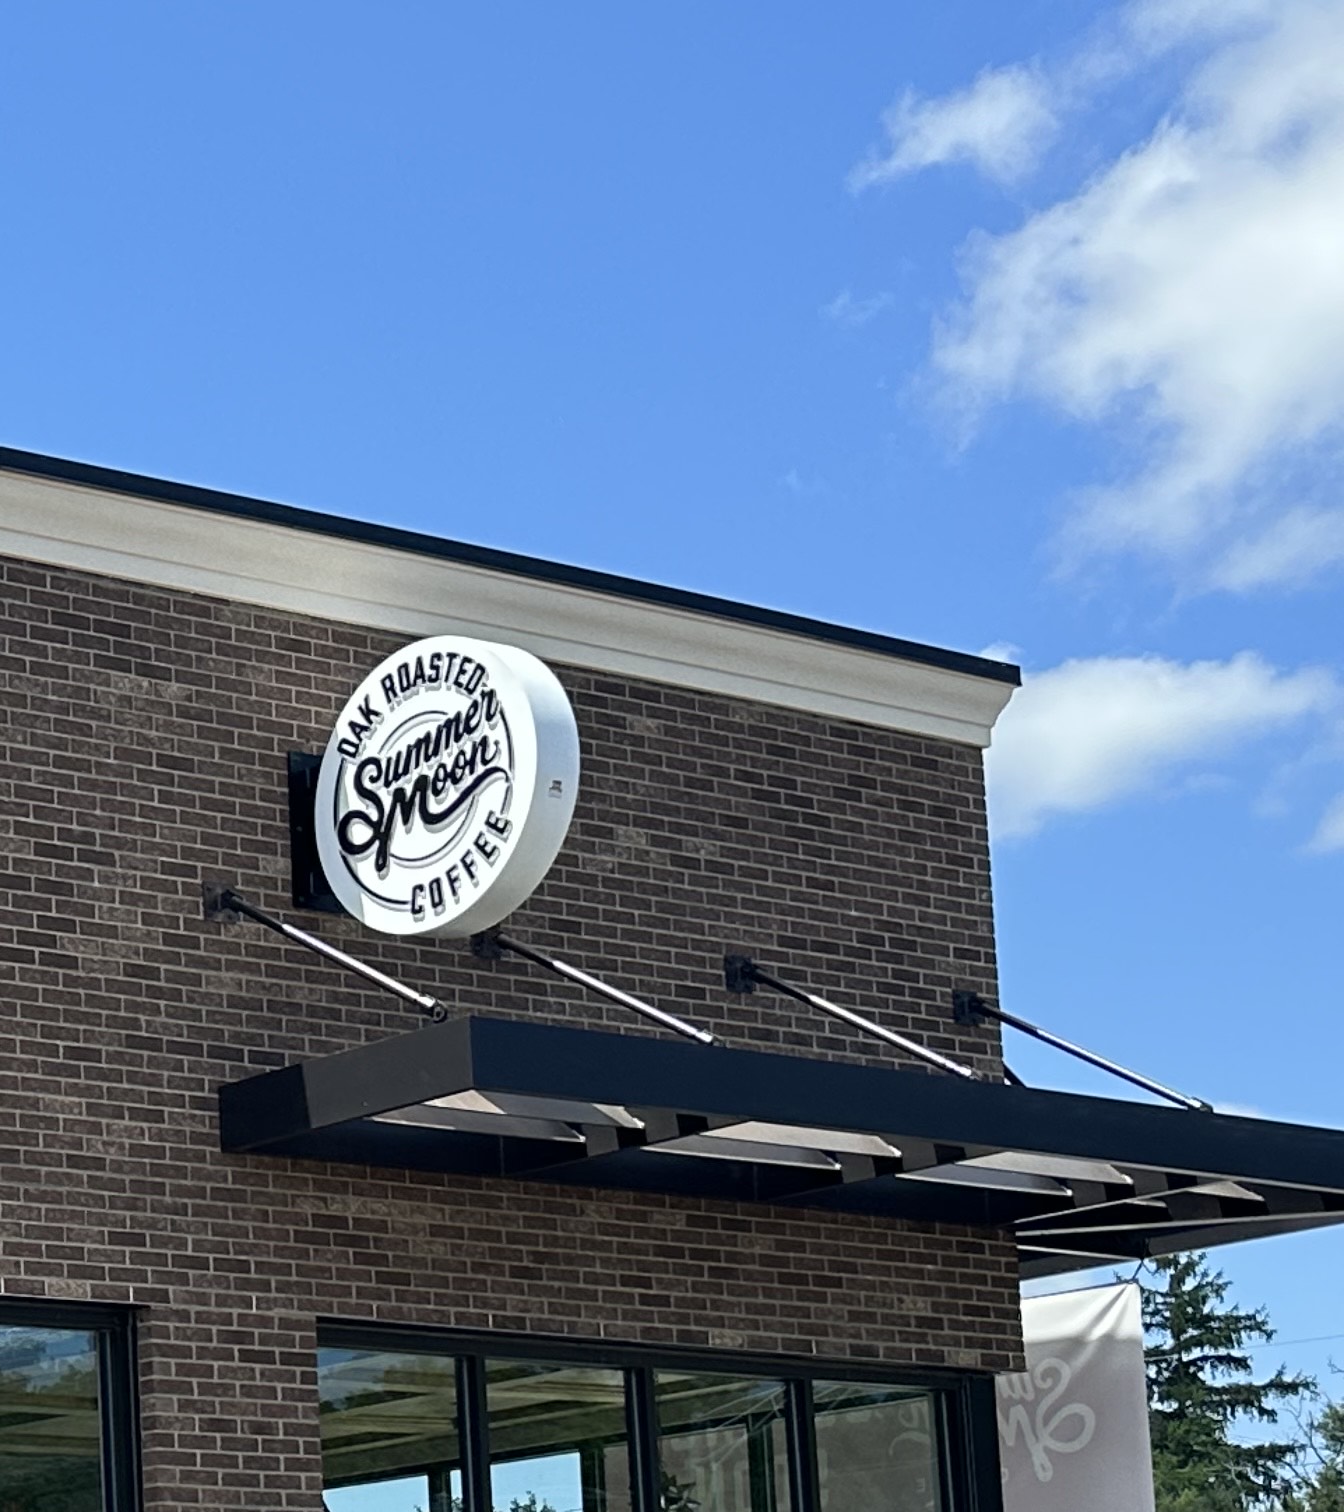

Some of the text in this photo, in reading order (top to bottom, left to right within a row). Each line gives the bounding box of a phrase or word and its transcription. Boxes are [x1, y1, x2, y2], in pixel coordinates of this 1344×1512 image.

[337, 652, 486, 759] OAK ROASTED
[338, 686, 499, 855] Summer
[374, 734, 510, 873] Moon
[410, 810, 512, 915] COFFEE
